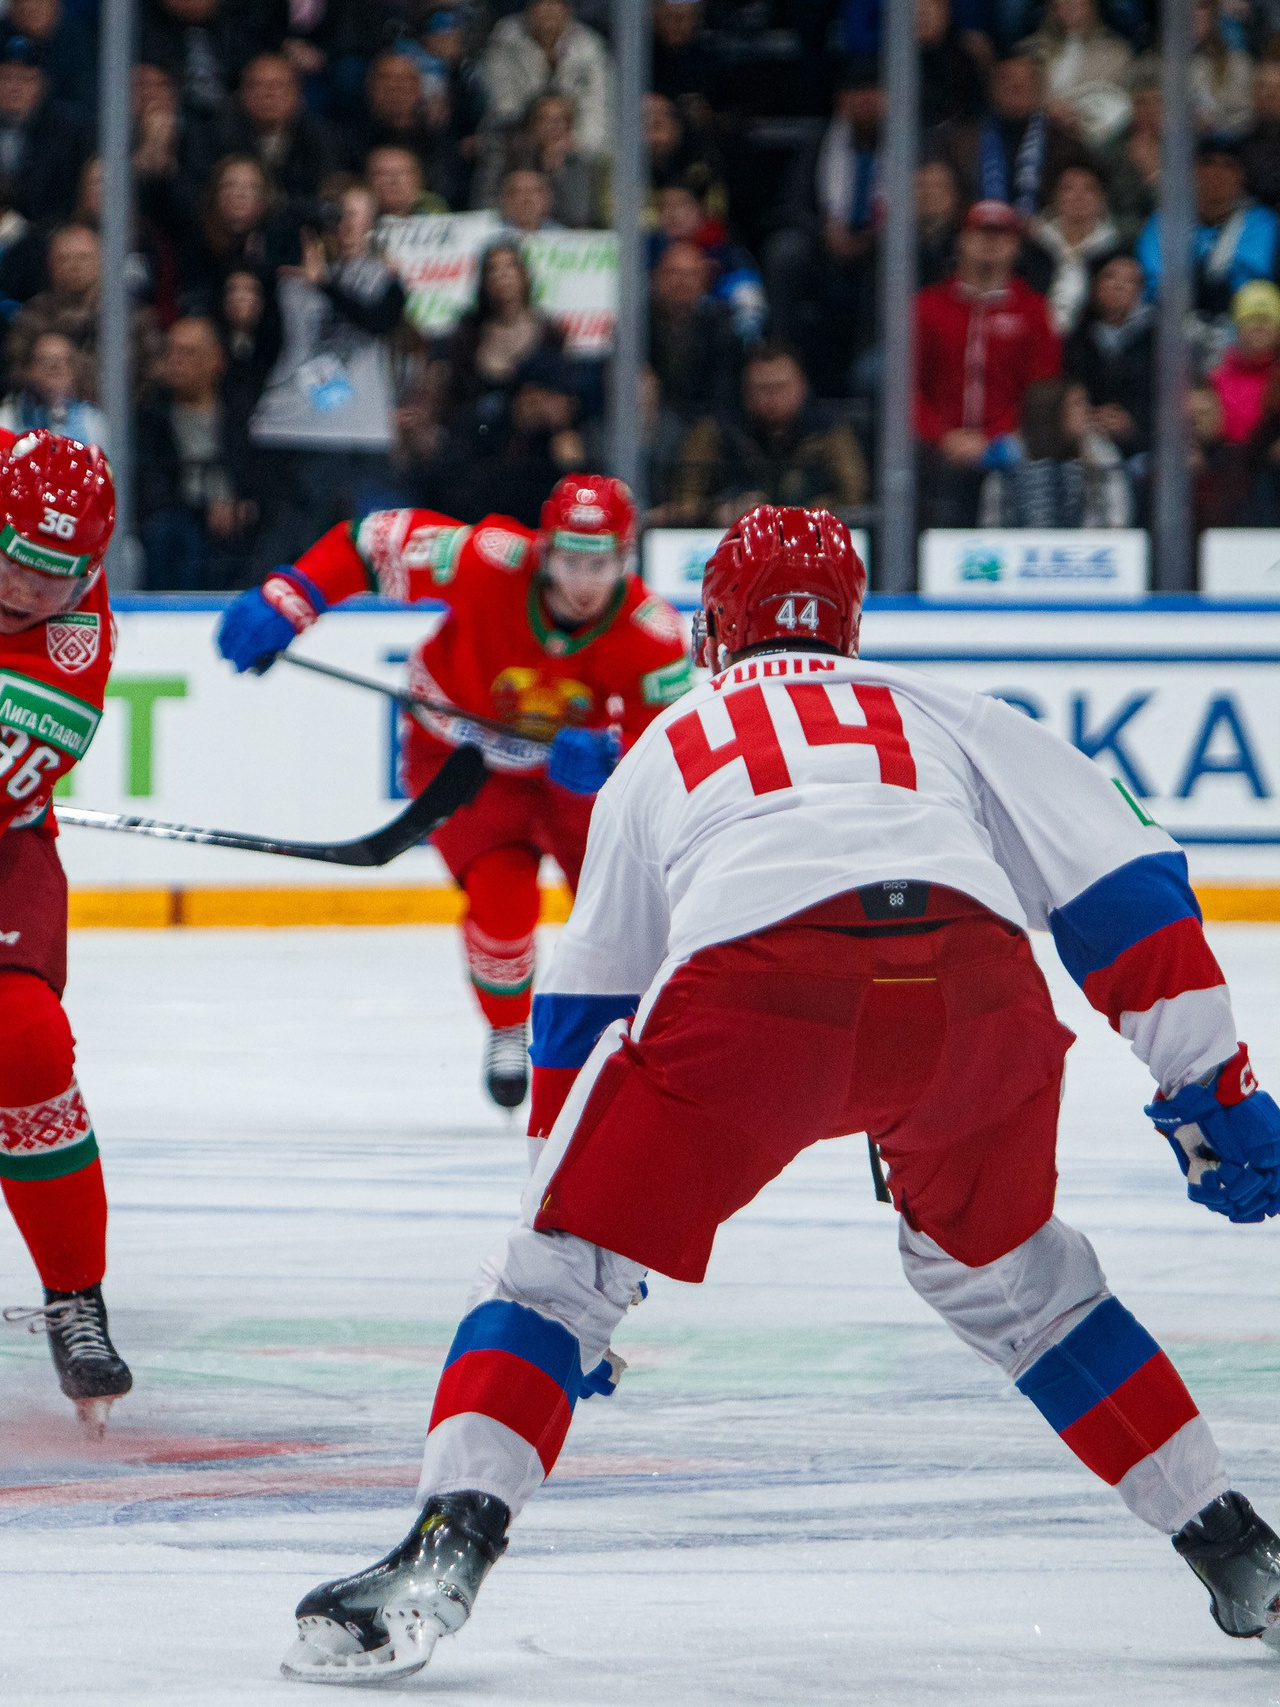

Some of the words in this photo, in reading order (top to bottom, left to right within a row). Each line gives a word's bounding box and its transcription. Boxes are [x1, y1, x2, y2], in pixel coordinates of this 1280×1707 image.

[38, 507, 78, 540] 36
[775, 598, 819, 629] 44
[709, 658, 835, 692] YUDIN
[665, 683, 917, 796] 44
[883, 881, 908, 890] PRO
[889, 892, 905, 906] 88
